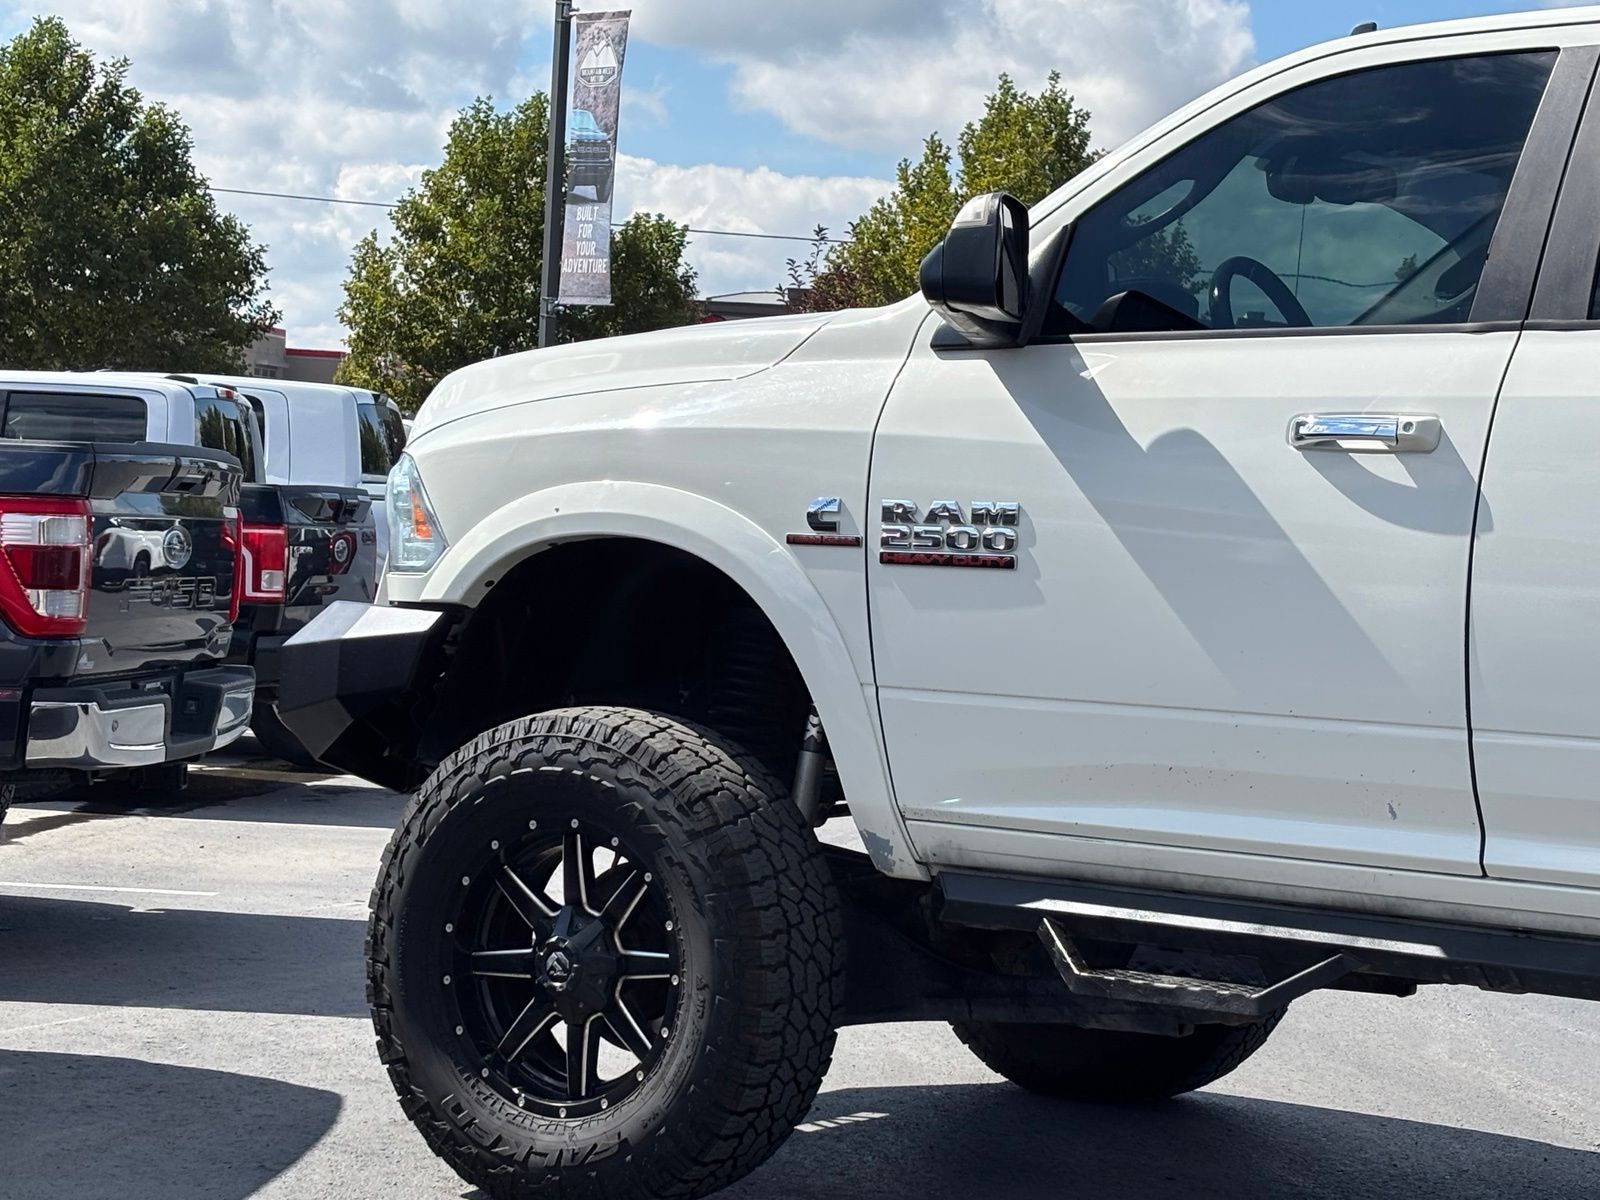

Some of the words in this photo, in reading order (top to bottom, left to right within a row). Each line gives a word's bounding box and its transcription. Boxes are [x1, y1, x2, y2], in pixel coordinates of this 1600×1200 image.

[576, 206, 599, 221] BUILT
[578, 223, 593, 239] FOR
[576, 241, 596, 256] YOUR
[562, 258, 608, 274] ADVENTURE
[881, 498, 1020, 526] RAM
[880, 524, 1018, 552] 2500
[882, 552, 950, 565] HEAVY
[952, 555, 1010, 567] DUTY
